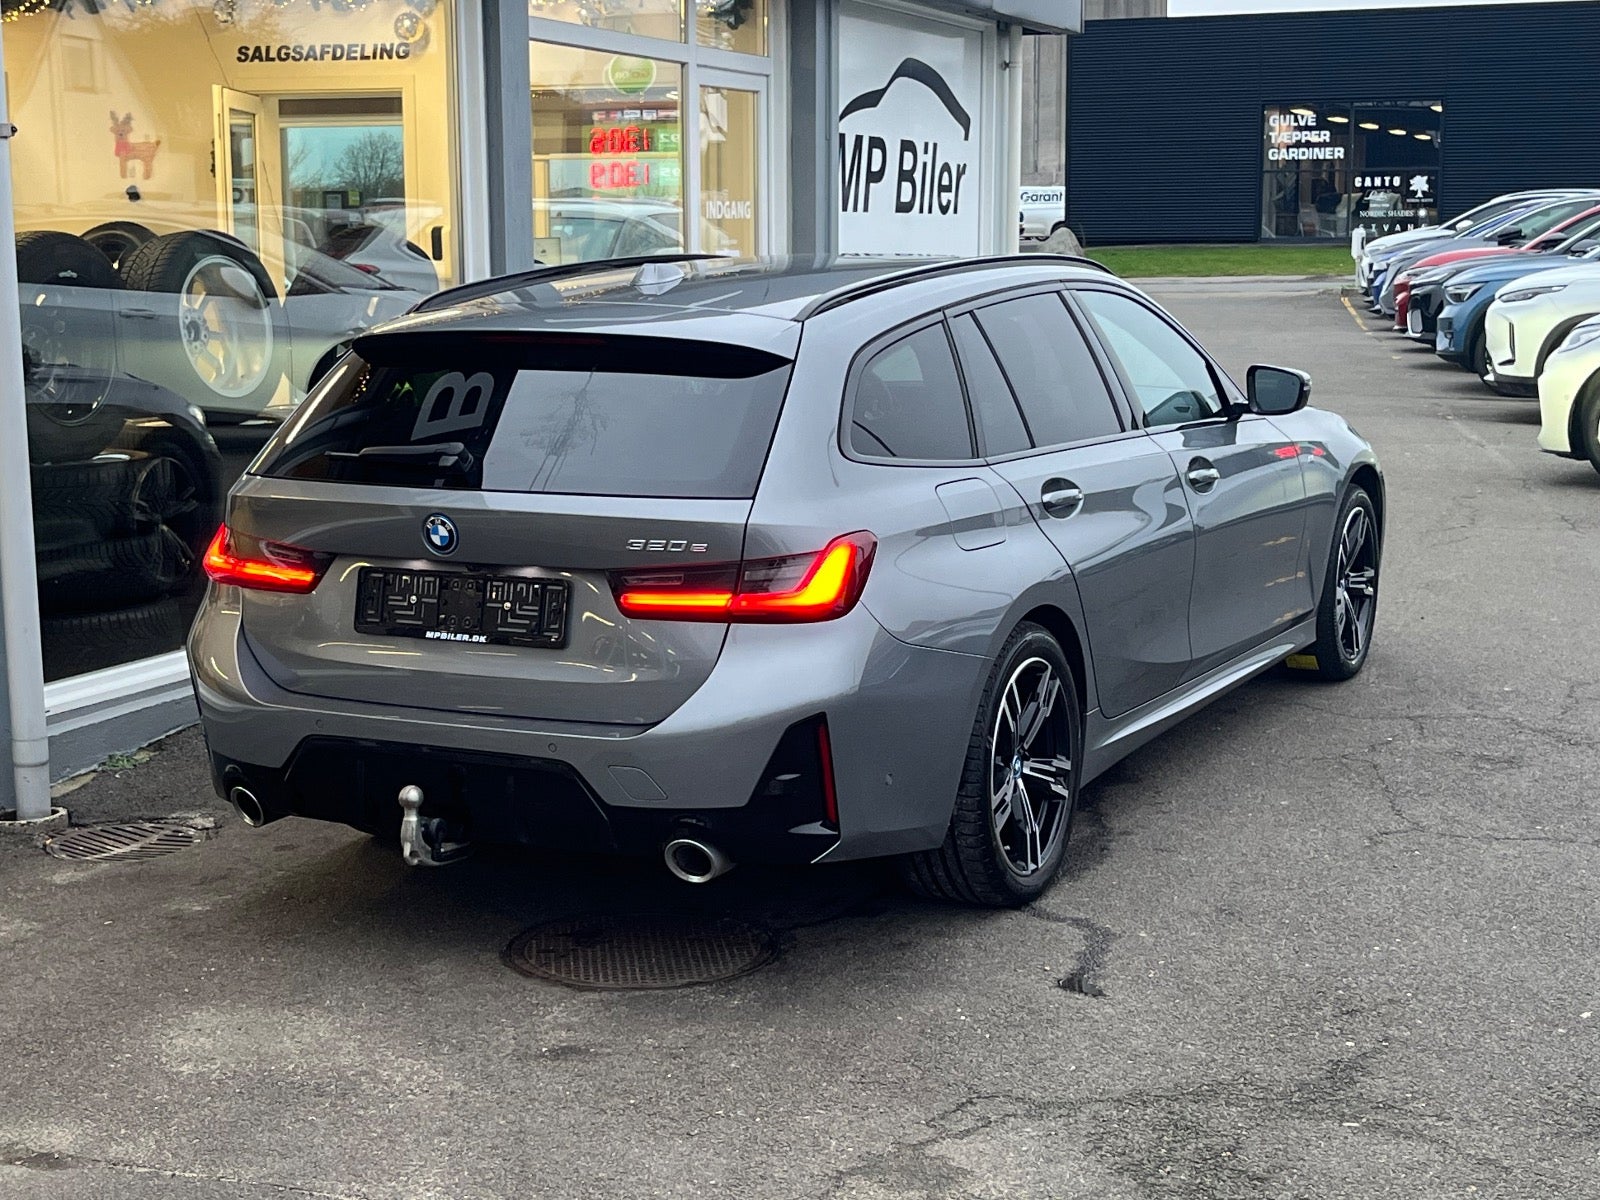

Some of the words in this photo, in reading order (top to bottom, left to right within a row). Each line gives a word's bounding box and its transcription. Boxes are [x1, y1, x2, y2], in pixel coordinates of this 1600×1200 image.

[236, 42, 410, 62] SALGSAFDELING
[1269, 114, 1317, 127] GULVE
[1269, 130, 1331, 143] TÆPPER
[1268, 147, 1345, 160] GARDINER
[839, 132, 887, 213] MP
[895, 138, 967, 215] Biler
[1354, 175, 1401, 187] CANTO
[1020, 191, 1063, 202] Garant
[706, 200, 751, 219] INDGANG
[1387, 209, 1414, 217] SHADES
[425, 630, 487, 643] MPBILER.DK
